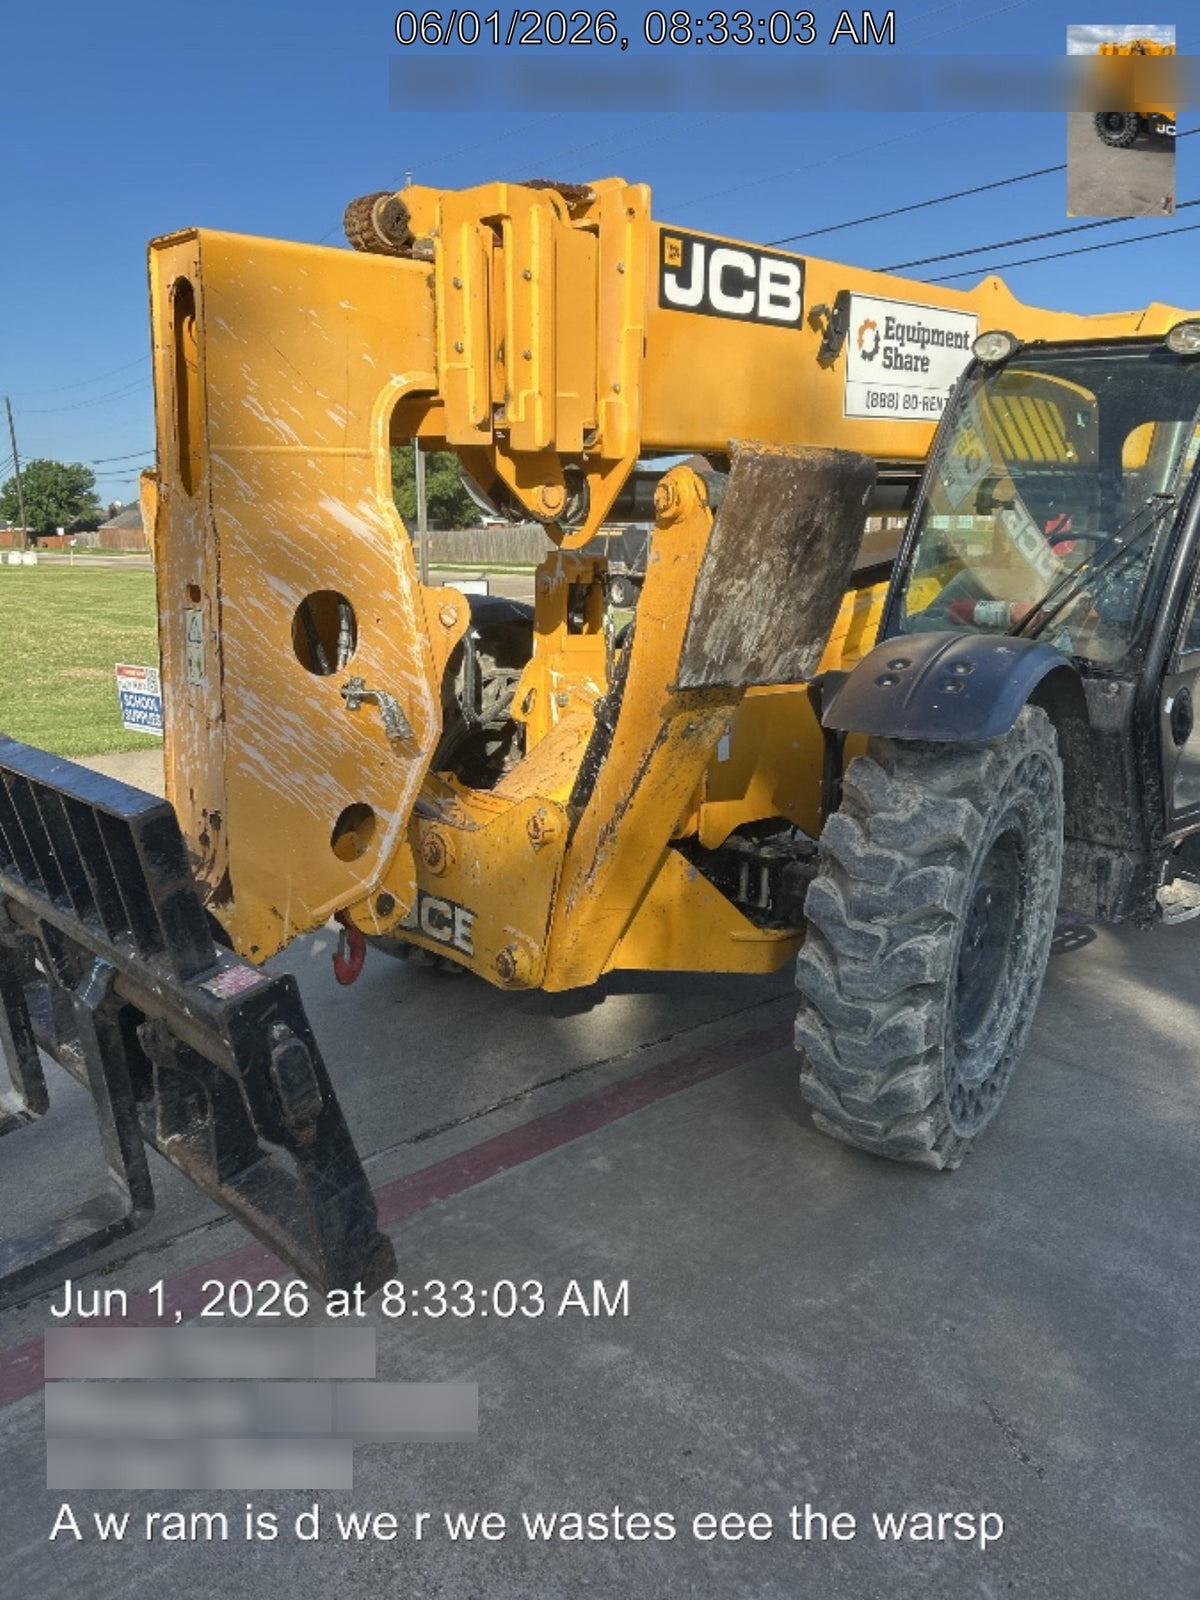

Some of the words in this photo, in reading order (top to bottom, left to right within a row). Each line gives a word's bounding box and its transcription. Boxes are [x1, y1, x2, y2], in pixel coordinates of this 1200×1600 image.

[664, 243, 802, 321] JCB
[883, 315, 970, 351] Equipment
[882, 346, 931, 373] Share
